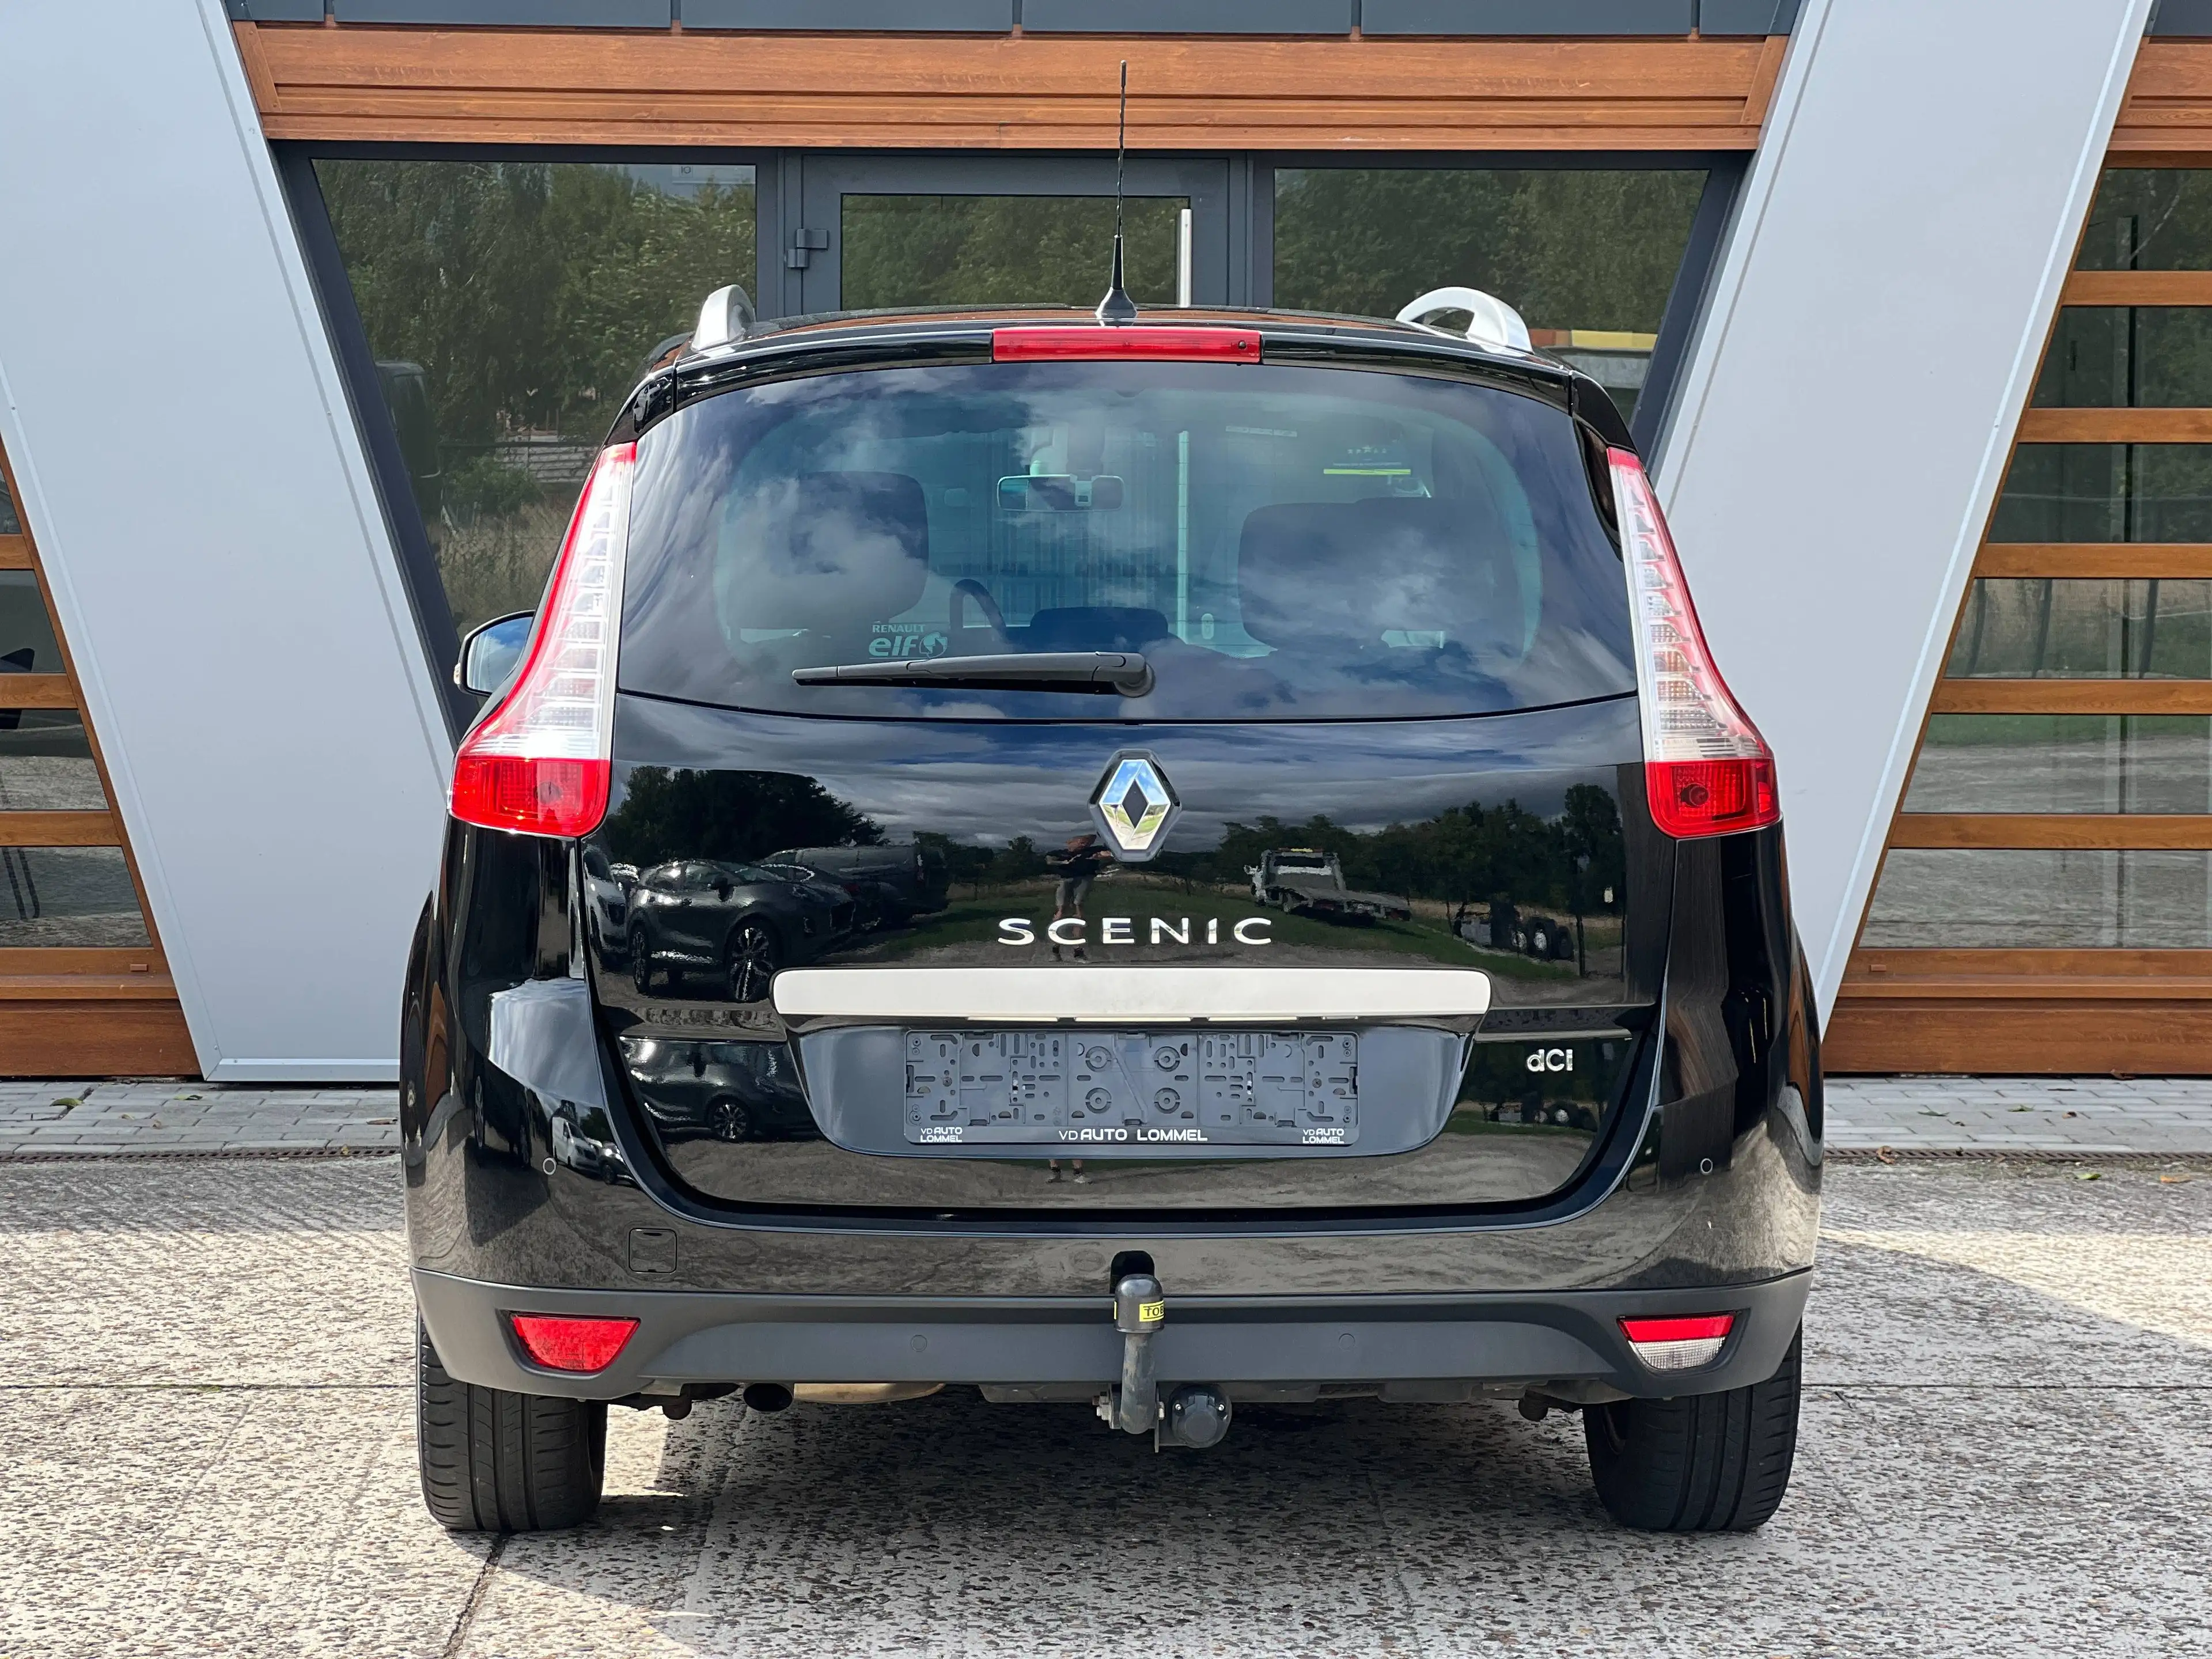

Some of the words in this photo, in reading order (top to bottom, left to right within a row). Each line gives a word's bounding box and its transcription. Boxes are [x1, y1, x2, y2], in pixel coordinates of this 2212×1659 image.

[872, 624, 926, 632] RENAULT
[869, 635, 919, 656] elf
[998, 917, 1272, 945] SCENIC
[1080, 1128, 1128, 1141] AUTO
[1137, 1129, 1208, 1141] LOMMEL
[1316, 1128, 1344, 1136] AUTO
[1302, 1136, 1344, 1144] LOMMEL
